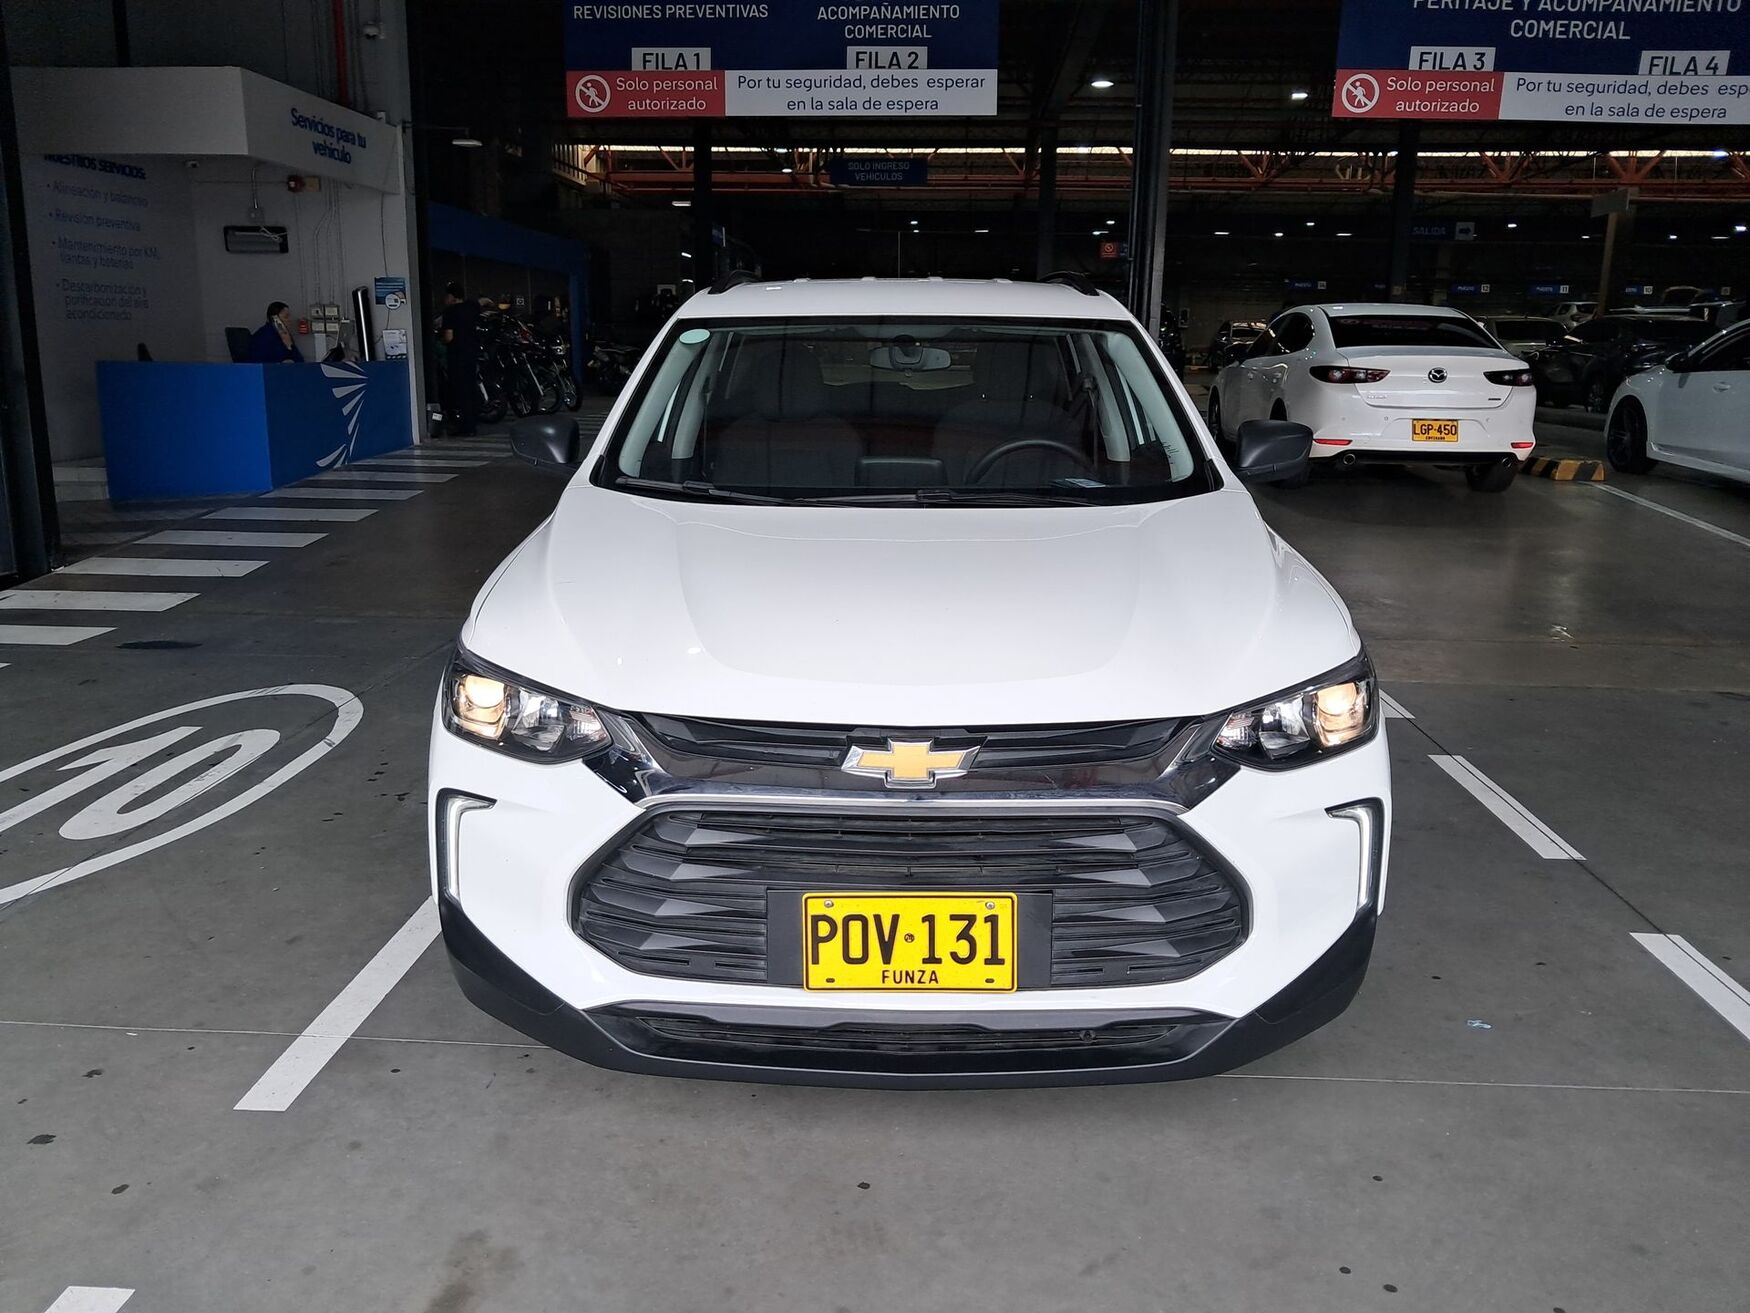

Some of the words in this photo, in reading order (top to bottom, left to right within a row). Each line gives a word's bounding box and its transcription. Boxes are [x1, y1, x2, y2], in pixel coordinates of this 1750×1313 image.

[573, 5, 662, 19] REVISIONES
[665, 4, 769, 19] PREVENTIVAS
[816, 3, 960, 20] ACOMPAÑAMIENTO
[844, 24, 932, 39] COMERCIAL
[1510, 19, 1631, 40] COMERCIAL
[642, 52, 689, 71] FILA
[692, 52, 701, 71] 1
[855, 51, 900, 70] FILA
[907, 51, 920, 70] 2
[1417, 51, 1467, 71] FILA
[1472, 52, 1486, 70] 3
[1648, 55, 1698, 75] FILA
[1705, 55, 1719, 75] 4
[616, 77, 649, 91] Solo
[653, 77, 718, 94] personal
[737, 75, 762, 90] Por
[766, 76, 781, 89] tu
[785, 74, 866, 93] seguridad,
[870, 75, 919, 89] debes
[926, 77, 985, 92] esperar
[1386, 77, 1423, 92] Solo
[1425, 78, 1495, 96] personal
[1516, 77, 1543, 93] Por
[1547, 79, 1563, 93] tu
[1566, 78, 1652, 98] seguridad,
[1656, 80, 1710, 96] debes
[1717, 84, 1750, 99] esp
[627, 97, 706, 111] autorizado
[786, 100, 807, 111] en
[811, 97, 824, 111] la
[828, 97, 858, 111] sala
[862, 97, 883, 111] de
[886, 99, 939, 114] espera
[1395, 98, 1480, 114] autorizado
[1564, 105, 1587, 117] en
[1590, 102, 1604, 117] la
[1607, 103, 1640, 118] sala
[1644, 103, 1666, 118] de
[1670, 107, 1727, 121] espera
[290, 107, 335, 138] Servicios
[336, 127, 356, 144] para
[357, 132, 367, 149] tu
[847, 161, 871, 171] SOLO
[872, 161, 910, 171] INGRESO
[1413, 423, 1434, 436] LGP
[1436, 423, 1457, 436] 450
[0, 726, 281, 840] 10
[810, 913, 900, 966] POV
[921, 913, 1006, 966] 131
[881, 969, 939, 984] FUNZA
